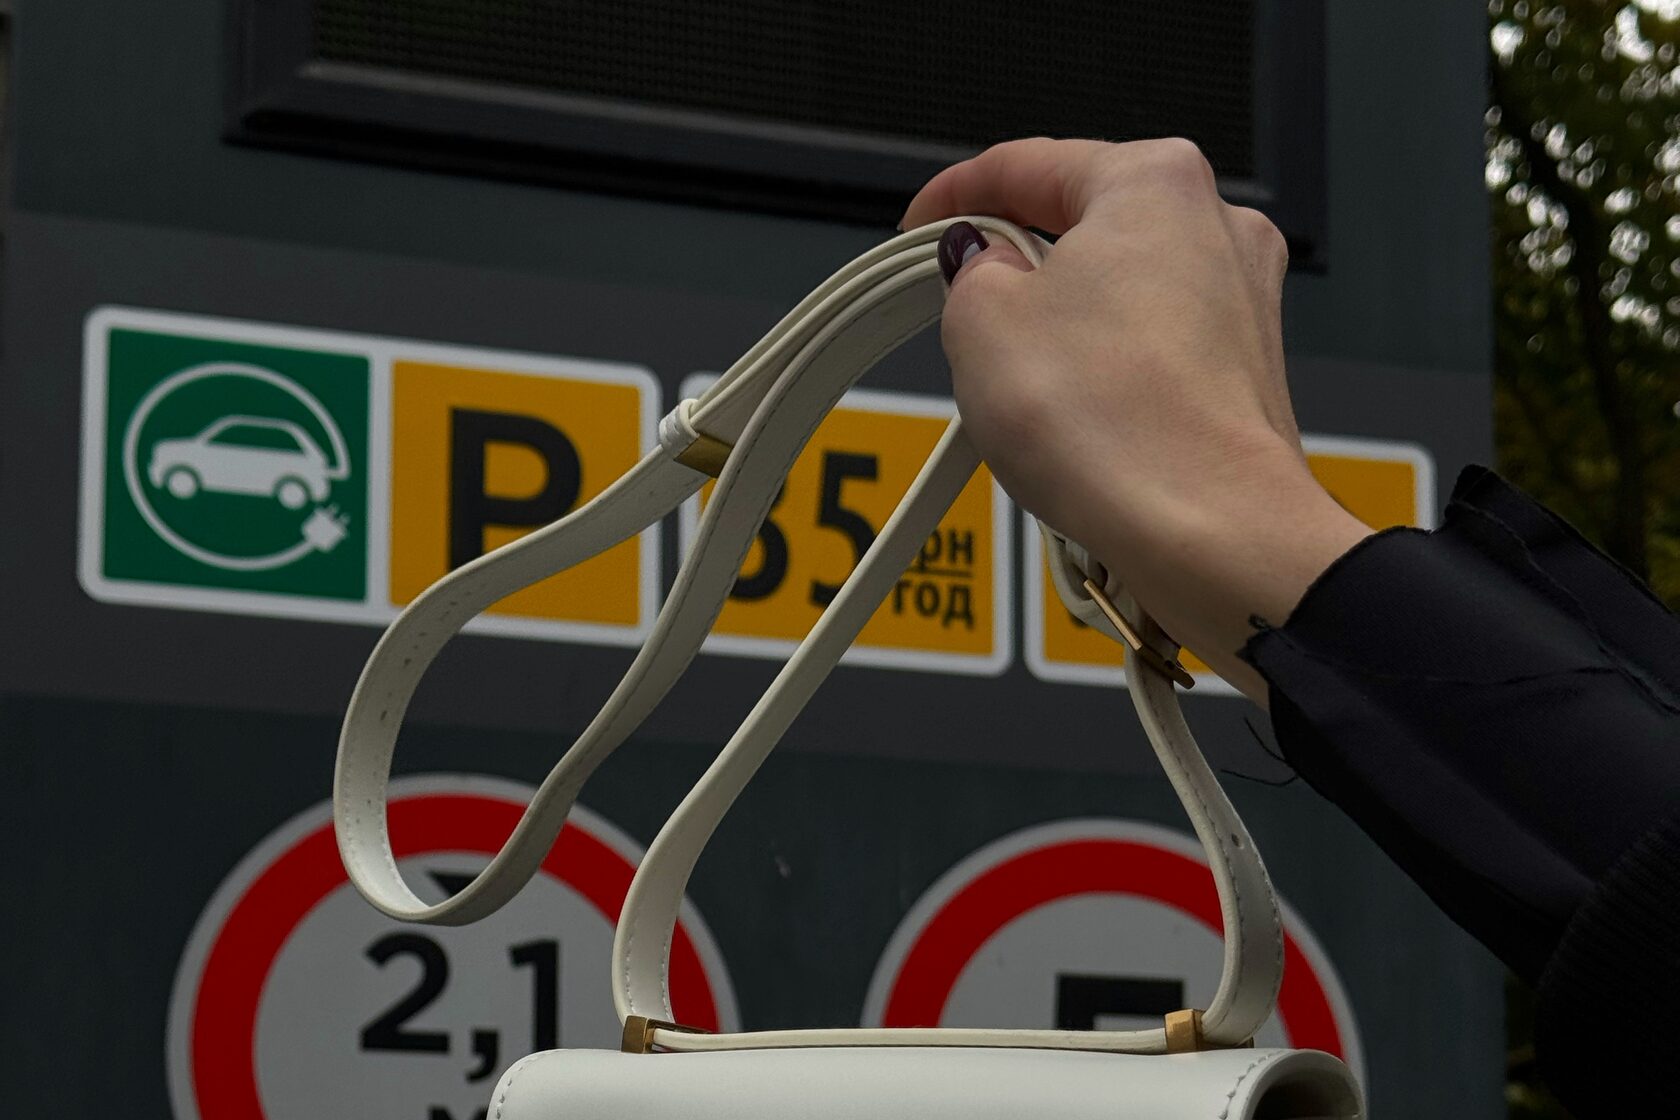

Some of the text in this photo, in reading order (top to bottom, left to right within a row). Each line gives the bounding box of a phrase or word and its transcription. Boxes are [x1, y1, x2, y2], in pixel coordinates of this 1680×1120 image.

[449, 408, 582, 571] P
[915, 528, 974, 572] рн
[892, 578, 974, 629] год
[360, 931, 559, 1083] 2,1
